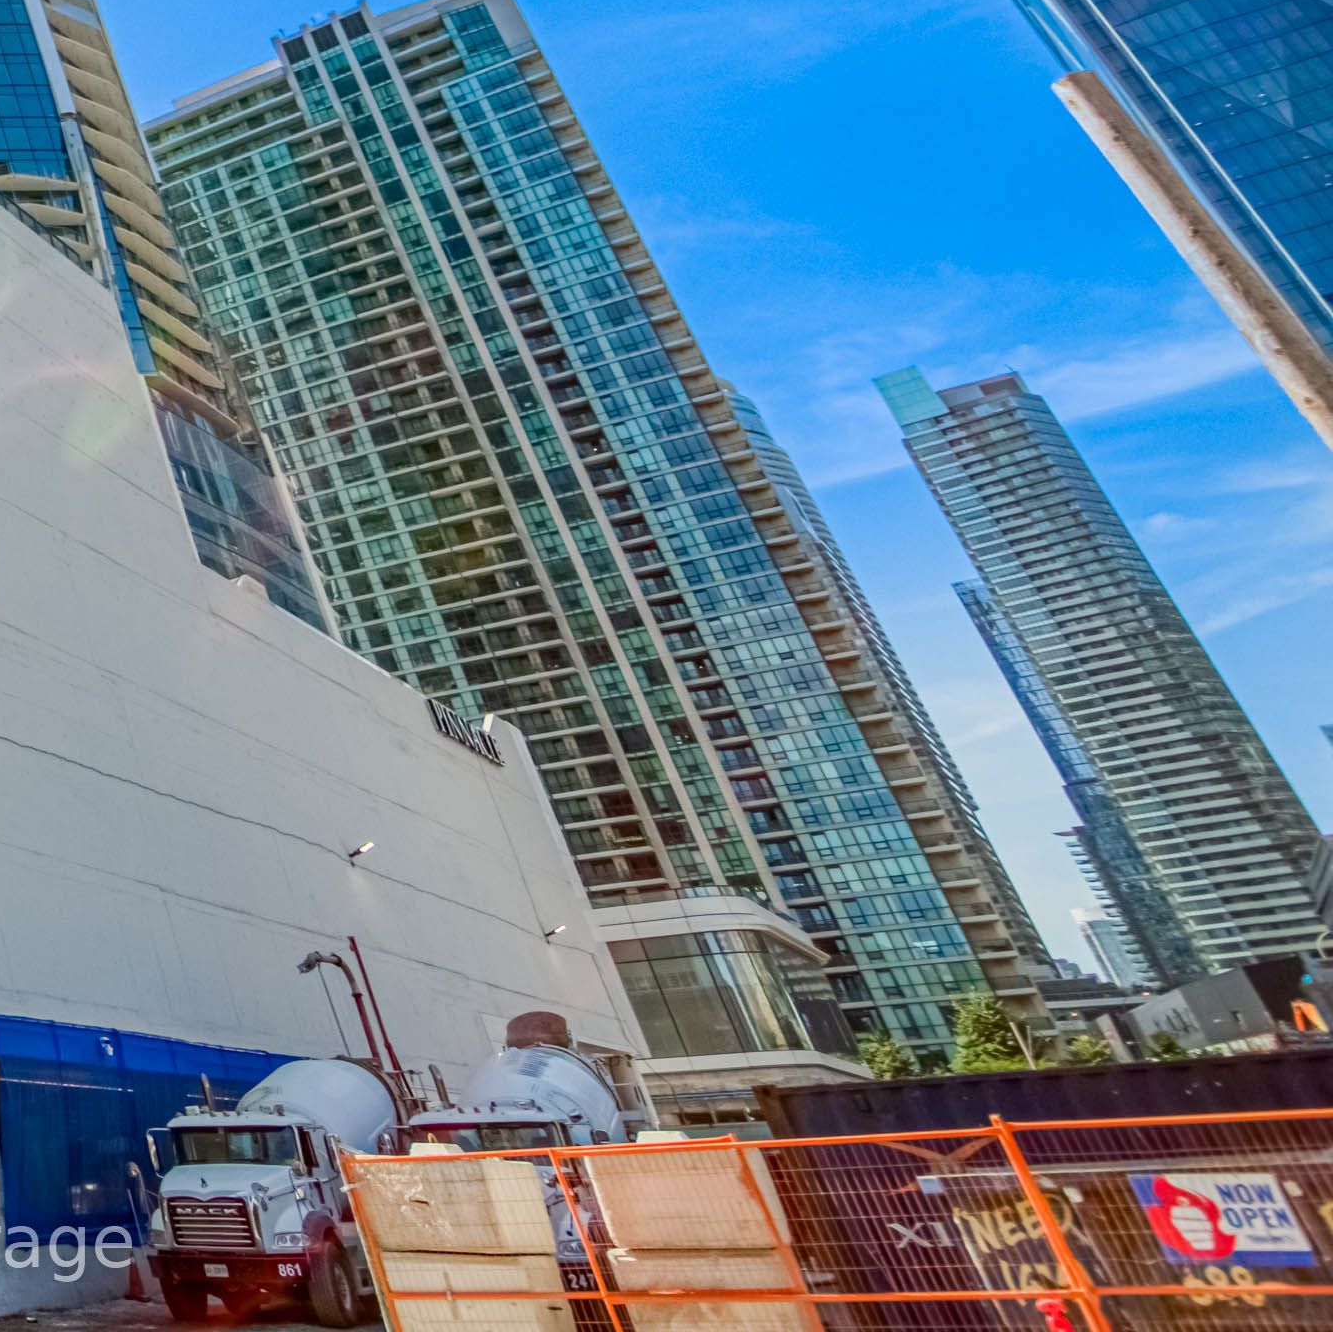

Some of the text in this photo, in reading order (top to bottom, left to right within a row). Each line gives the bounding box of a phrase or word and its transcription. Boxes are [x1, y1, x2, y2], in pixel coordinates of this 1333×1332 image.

[1215, 1183, 1276, 1205] NOW
[176, 1206, 238, 1215] MACK
[1222, 1206, 1296, 1229] OPEN
[277, 1263, 302, 1277] 861
